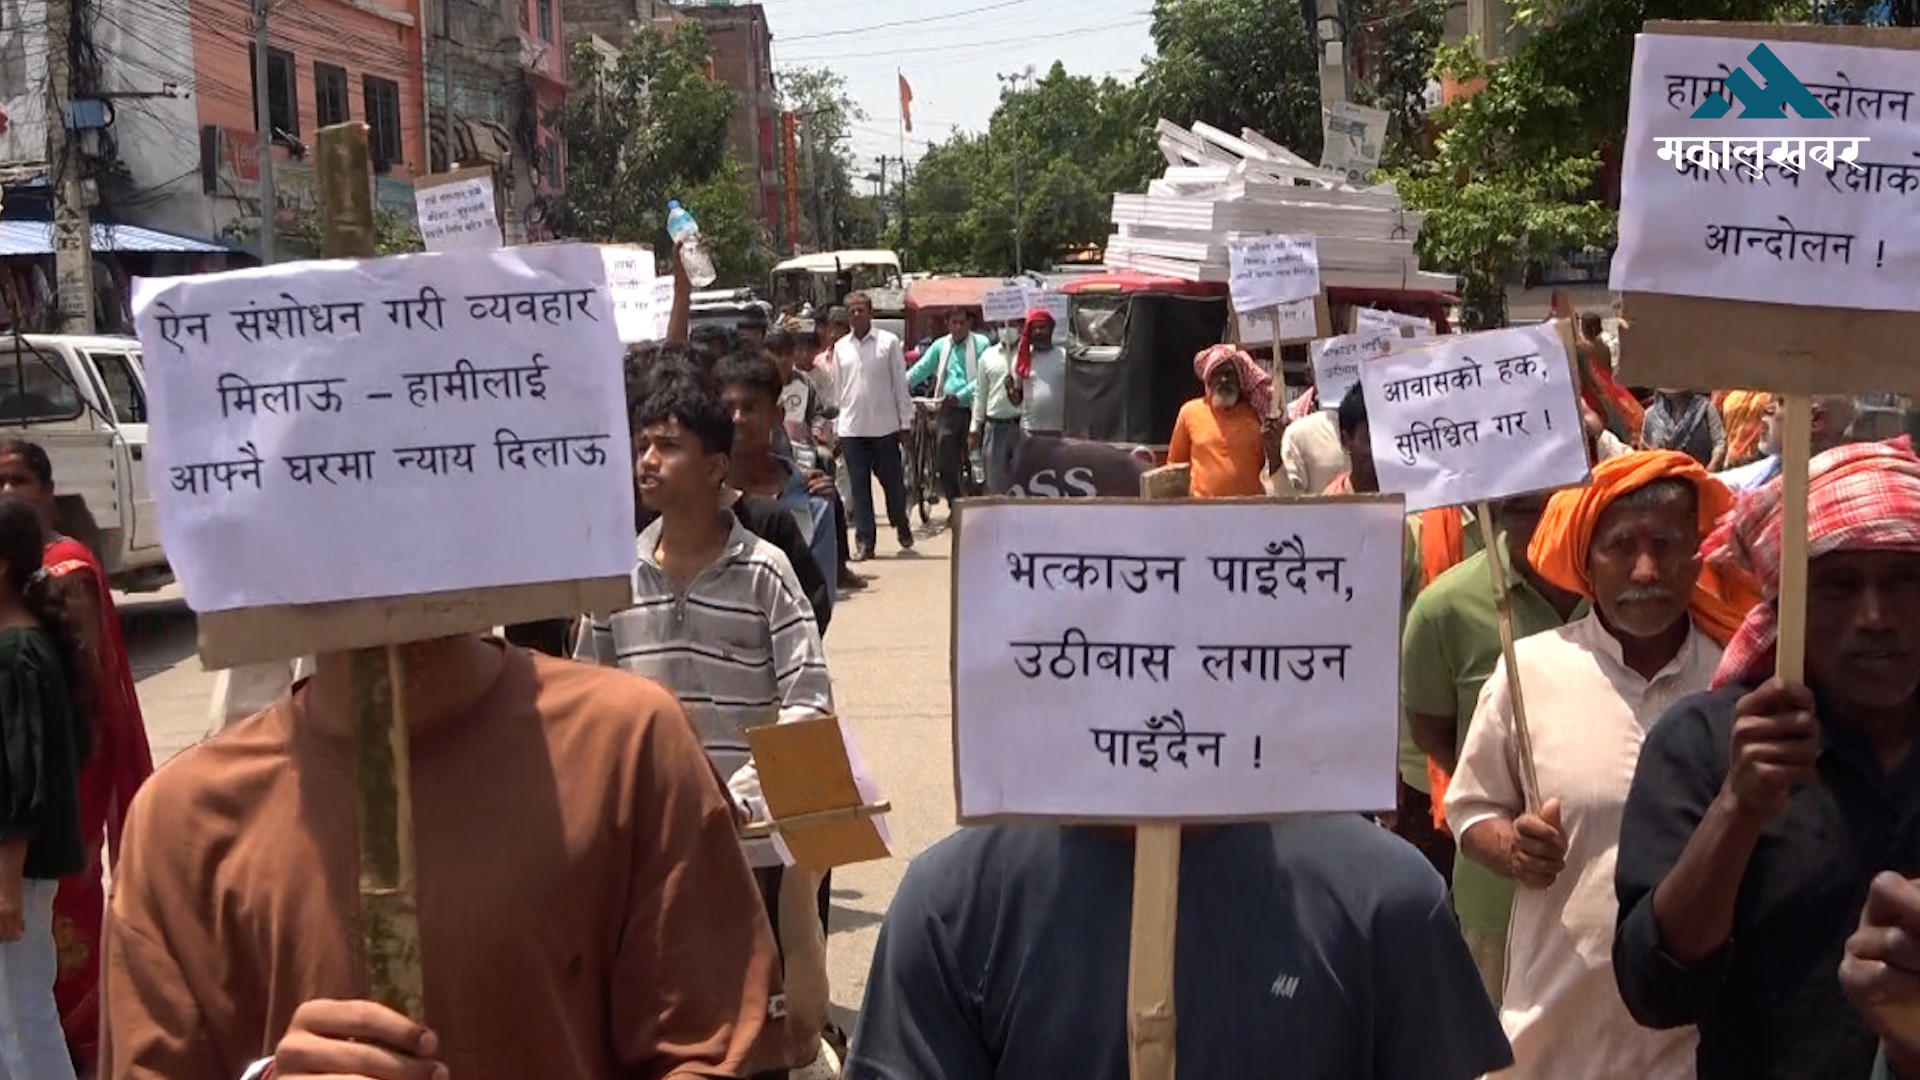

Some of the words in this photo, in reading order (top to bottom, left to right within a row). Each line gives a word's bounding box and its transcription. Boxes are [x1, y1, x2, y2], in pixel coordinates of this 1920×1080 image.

[1764, 71, 1914, 121] न्दोलन
[1704, 216, 1855, 264] आन्दोलन
[1876, 240, 1885, 268] !
[155, 302, 211, 354] ऐन
[230, 294, 363, 343] संशोधन
[383, 286, 445, 330] गरी
[465, 288, 598, 329] व्यवहार
[218, 373, 346, 418] मिलाऊ
[403, 353, 550, 405] हामीलाई
[1383, 357, 1481, 402] आवासको
[1495, 353, 1548, 381] हक,
[171, 442, 263, 495] आफ्नै
[283, 450, 374, 485] घरमा
[395, 444, 475, 476] न्याय
[492, 429, 610, 471] दिलाऊ
[1395, 418, 1479, 466] सुनिश्चित
[1492, 411, 1531, 436] गर
[1544, 409, 1552, 430] !
[1007, 552, 1186, 594] भत्काउन
[1208, 535, 1353, 603] पाइँदैन,
[1010, 629, 1175, 681] उठीबास
[1199, 644, 1352, 681] लगाउन
[1090, 710, 1226, 771] पाइँदैन
[1254, 734, 1262, 769] !
